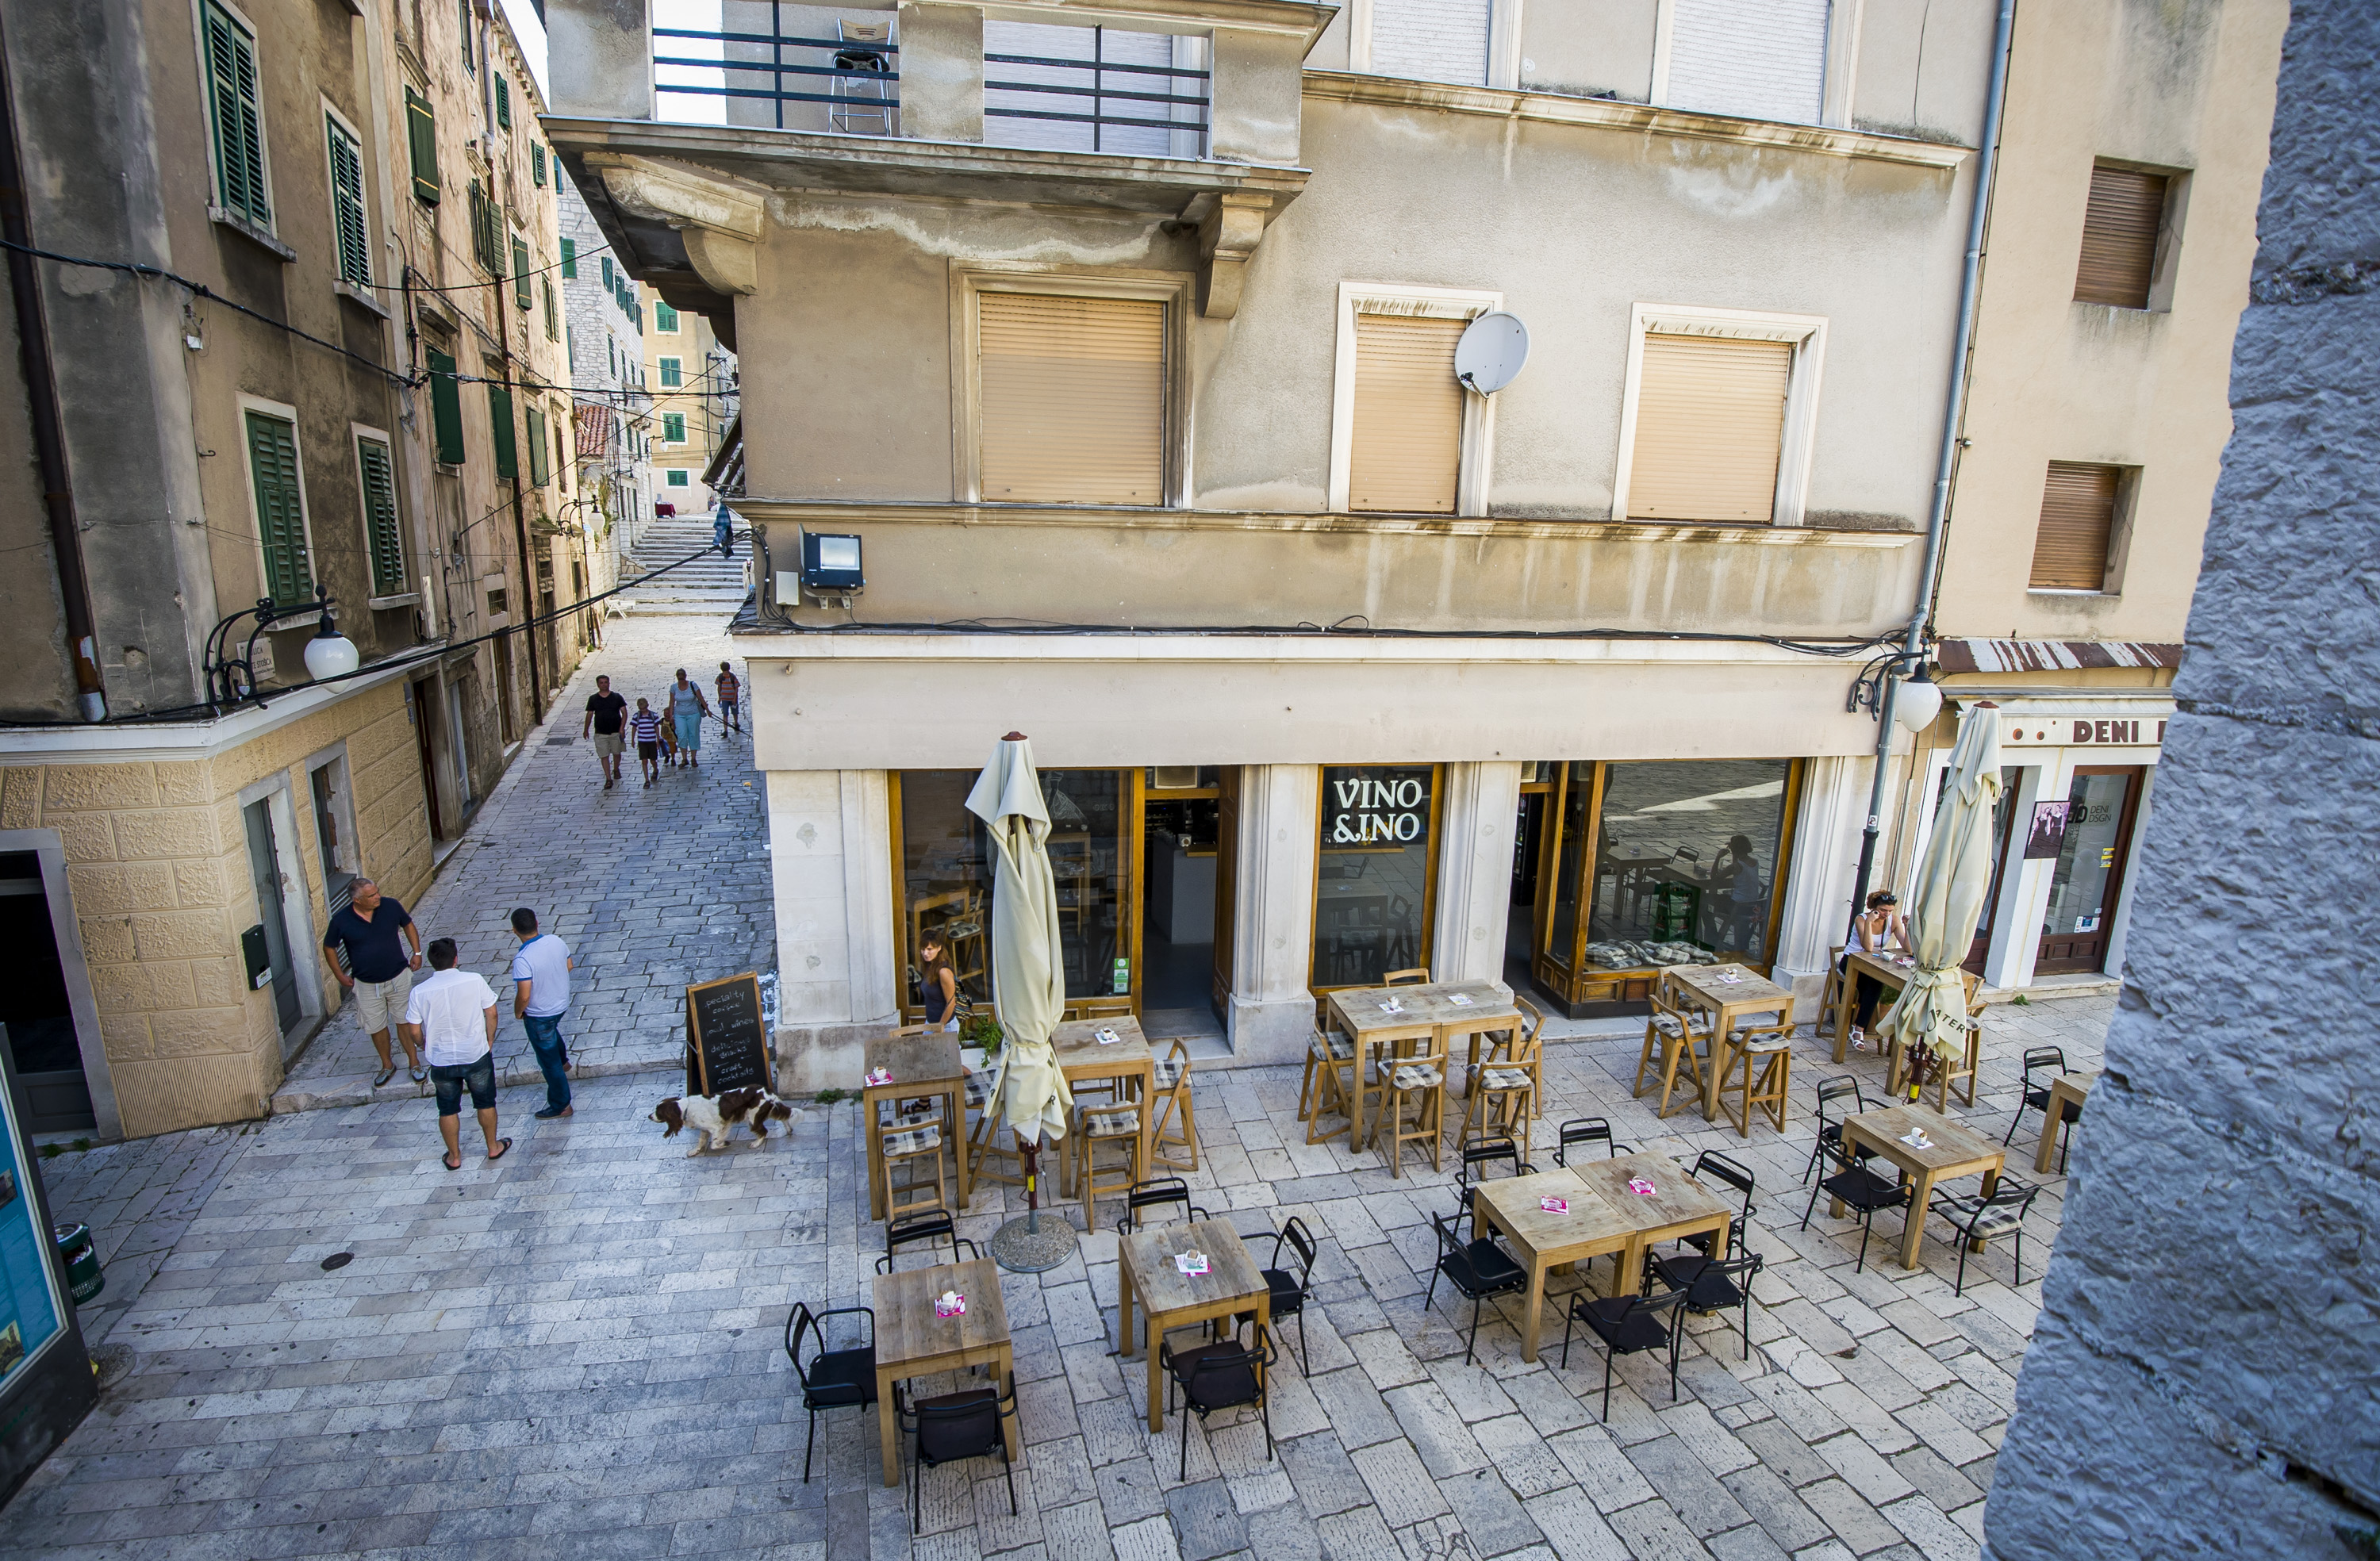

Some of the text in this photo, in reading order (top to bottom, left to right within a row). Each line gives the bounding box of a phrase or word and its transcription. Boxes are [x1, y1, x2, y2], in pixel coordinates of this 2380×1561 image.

[2073, 720, 2140, 743] DENI
[1333, 777, 1422, 809] VINO
[2088, 814, 2112, 823] DSGN
[2090, 805, 2109, 815] DENI
[1333, 812, 1420, 843] &INO
[716, 1067, 754, 1085] cocktails
[720, 1061, 743, 1074] craft
